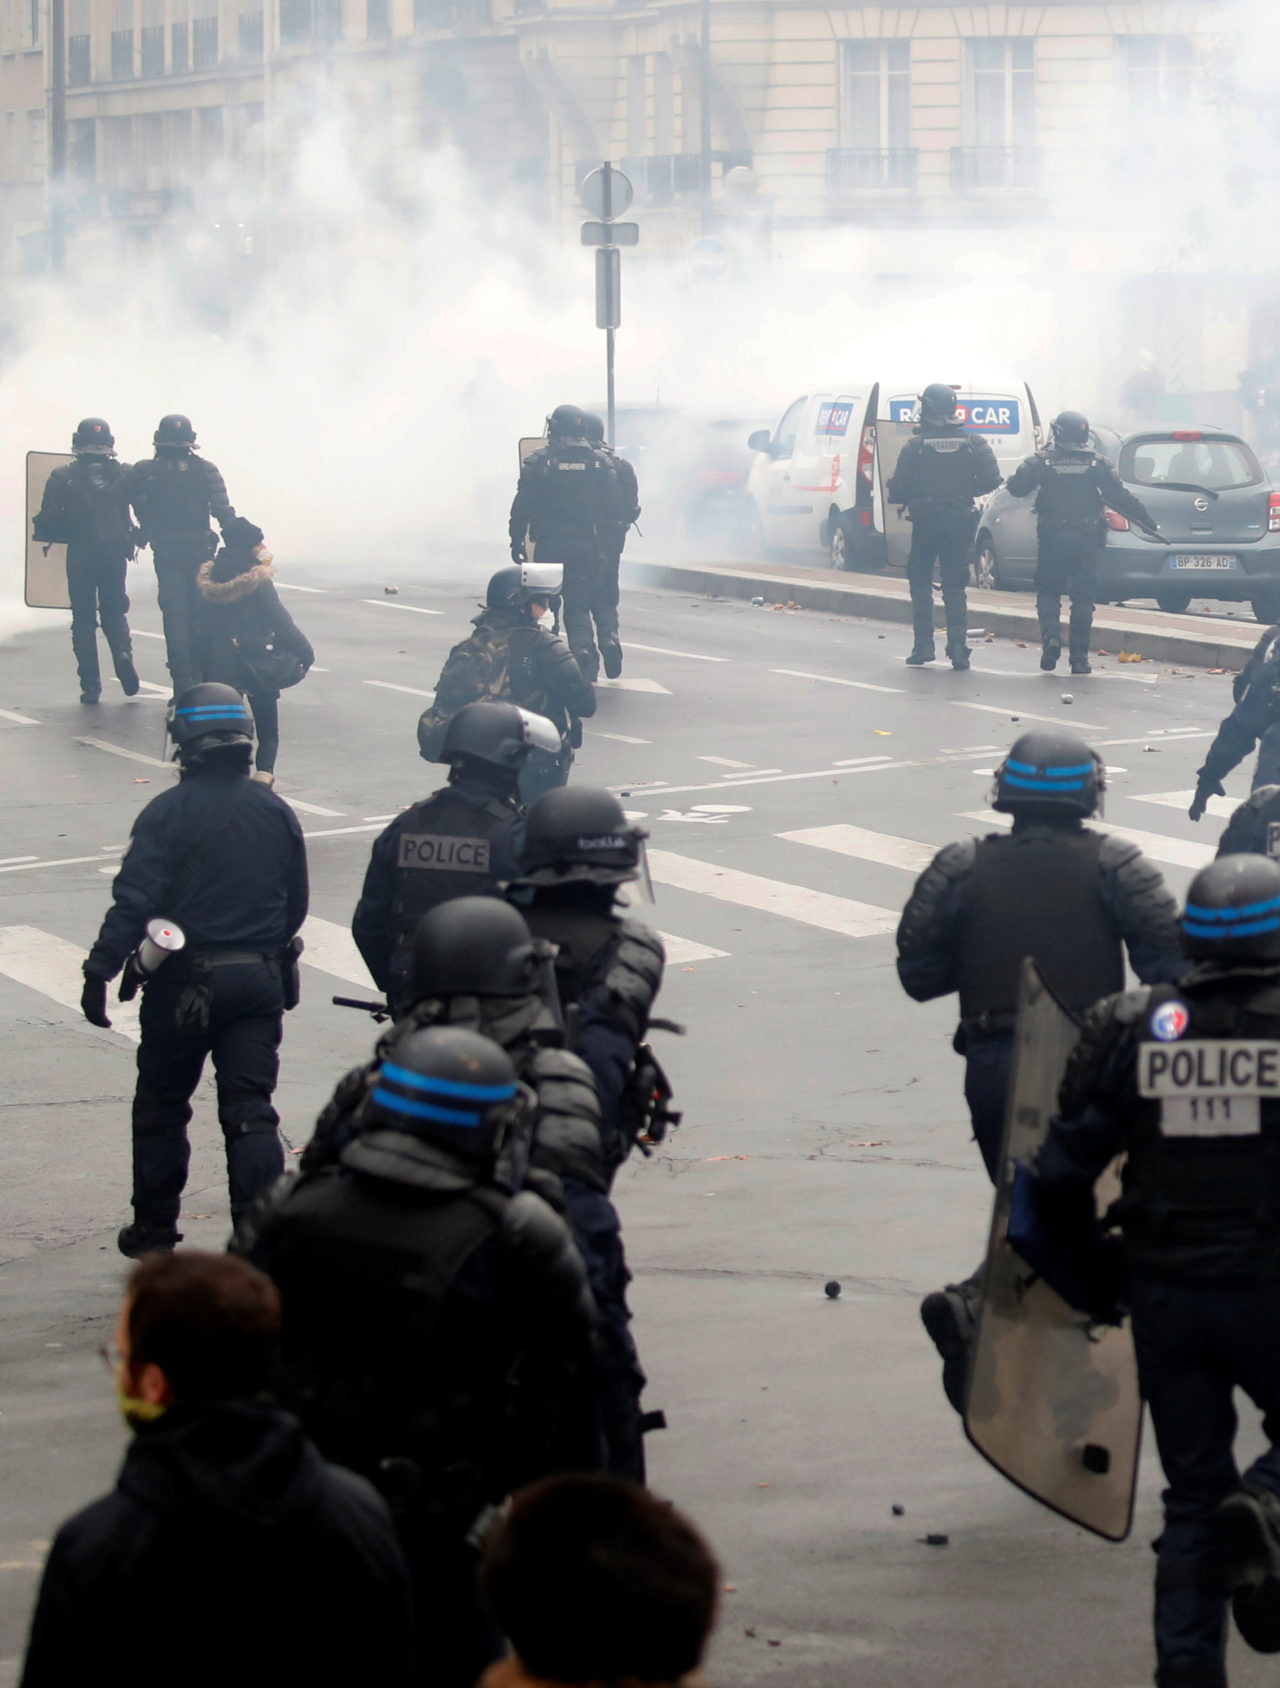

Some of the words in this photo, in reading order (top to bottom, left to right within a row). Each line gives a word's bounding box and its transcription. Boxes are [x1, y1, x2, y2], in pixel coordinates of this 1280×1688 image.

[972, 407, 1011, 424] CAR
[403, 839, 486, 866] POLICE
[1149, 1049, 1279, 1089] POLICE
[1191, 1097, 1231, 1121] 111
